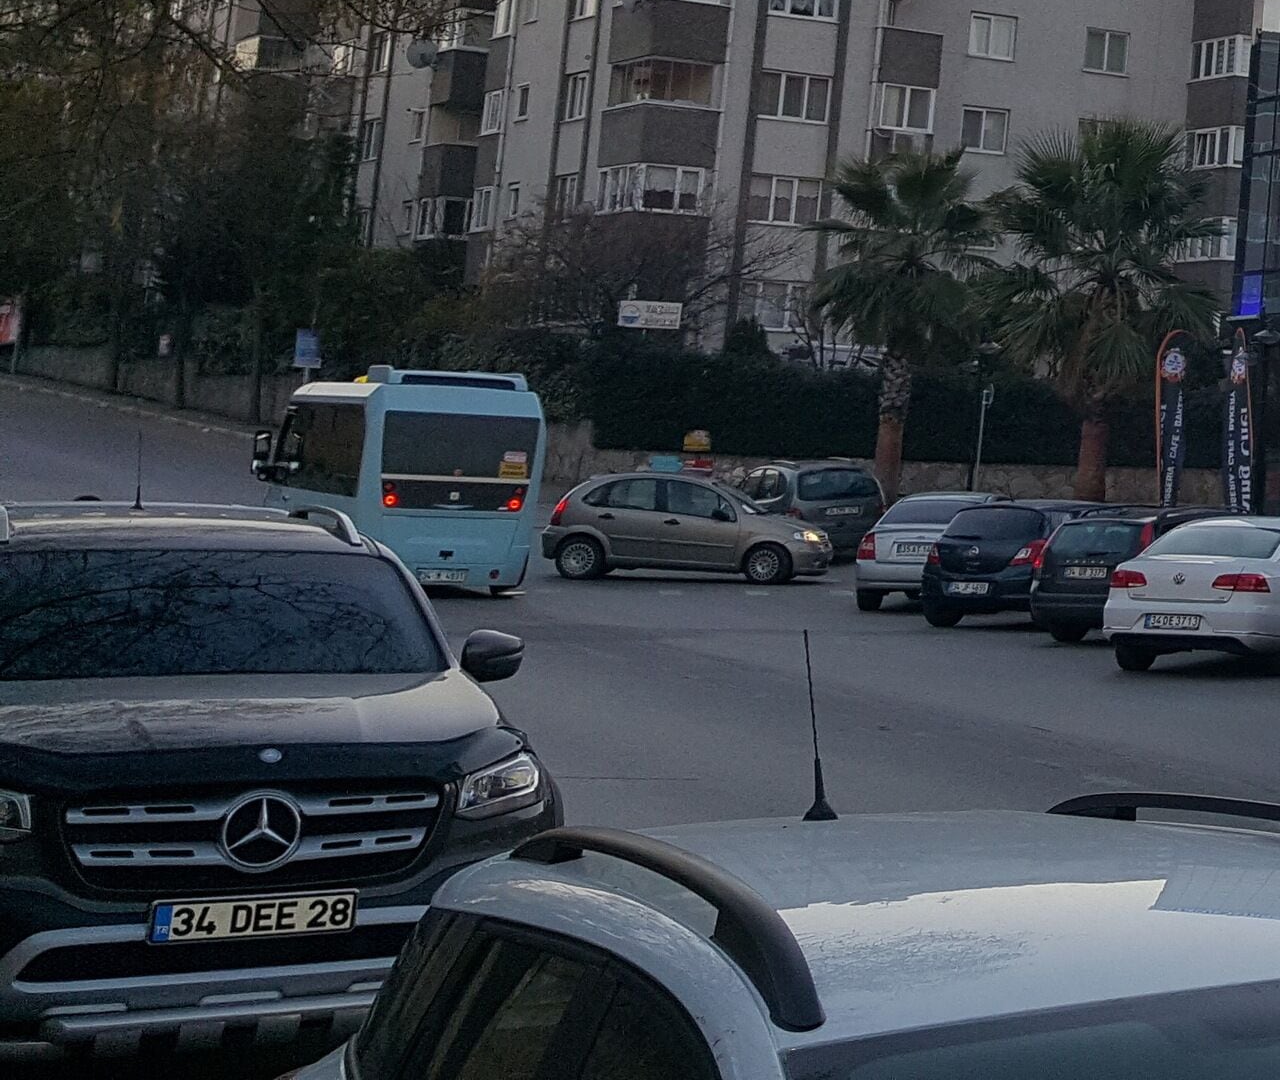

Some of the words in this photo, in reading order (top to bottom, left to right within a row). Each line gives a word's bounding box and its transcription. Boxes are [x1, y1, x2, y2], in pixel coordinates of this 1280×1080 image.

[172, 906, 217, 936] 34
[229, 901, 298, 933] DEE
[306, 897, 350, 929] 28
